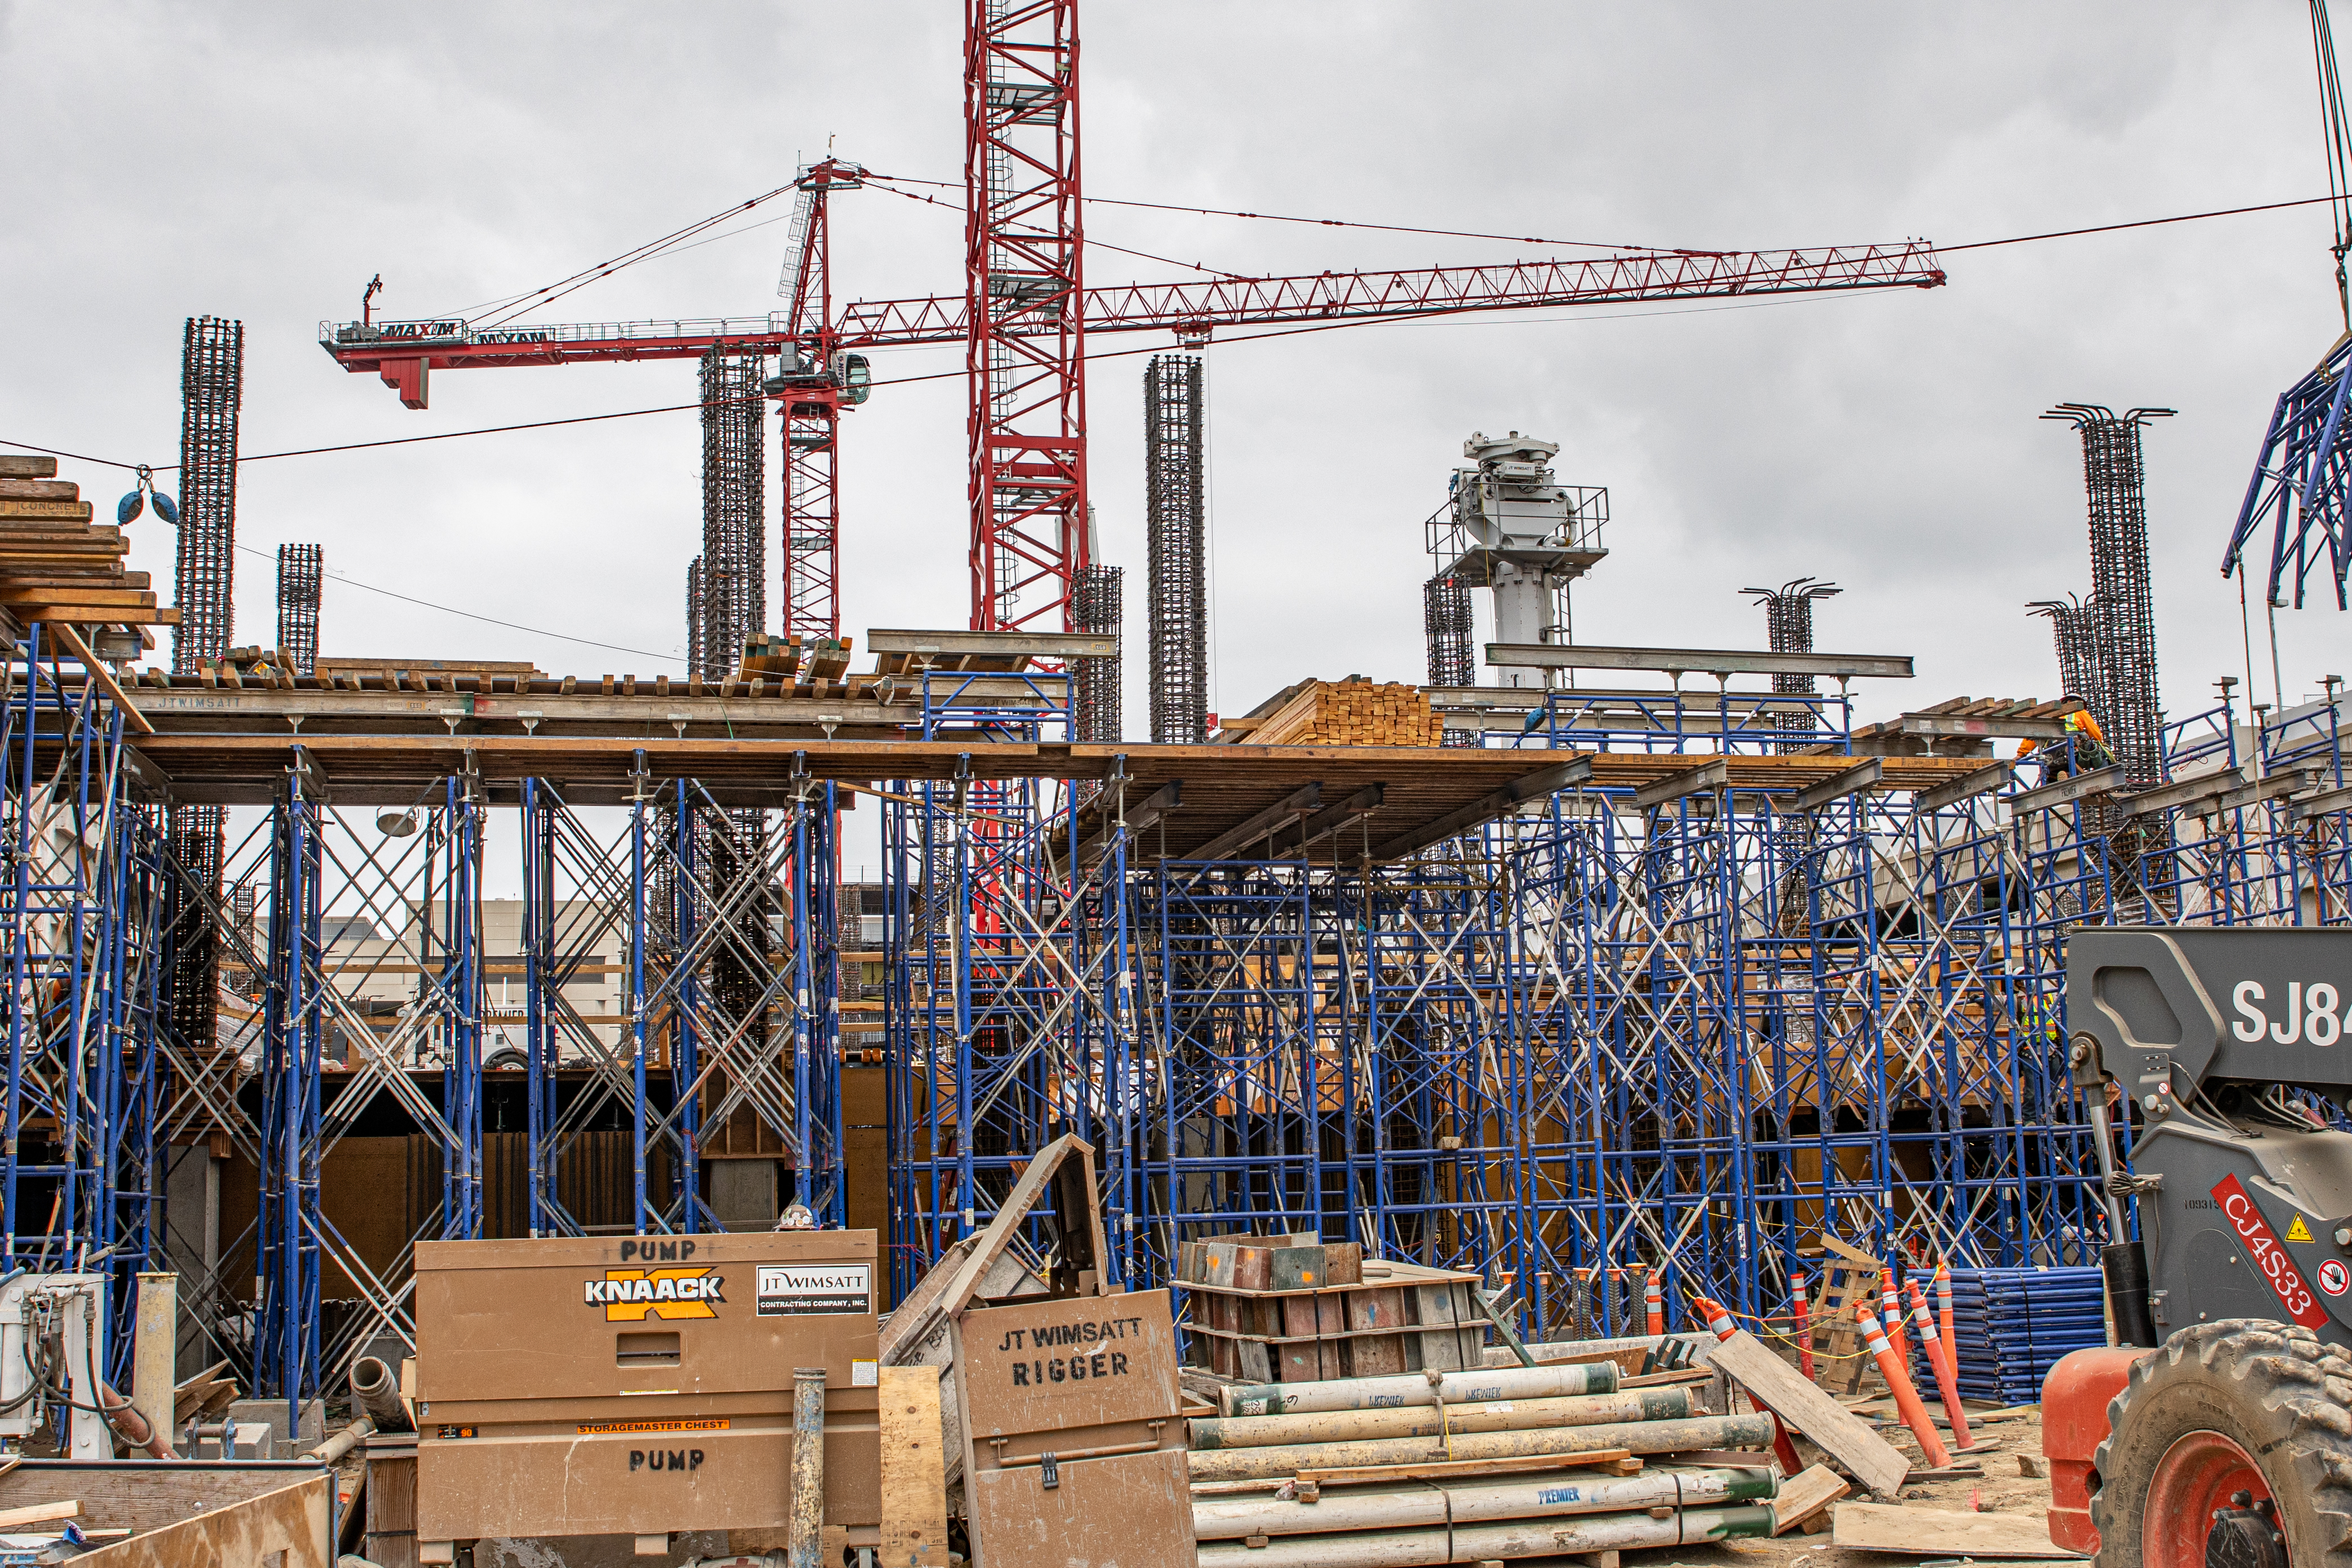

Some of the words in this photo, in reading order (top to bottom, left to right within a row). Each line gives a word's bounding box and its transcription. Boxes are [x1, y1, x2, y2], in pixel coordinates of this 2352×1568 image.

[385, 323, 456, 337] MAXIM
[2231, 981, 2352, 1047] SJ8
[621, 1241, 696, 1261] PUMP
[2225, 1193, 2312, 1316] CJ4S33
[585, 1276, 721, 1302] KNAACK
[763, 1278, 781, 1292] JT
[772, 1272, 863, 1289] WIMSATT
[999, 1329, 1027, 1352] JT
[1031, 1317, 1142, 1348] WIMSATT
[1013, 1352, 1128, 1387] RIGGER
[461, 1429, 473, 1437] 90
[580, 1422, 681, 1433] STORAGEMASTER
[629, 1449, 705, 1471] PUMP
[1538, 1487, 1580, 1505] PREMIER
